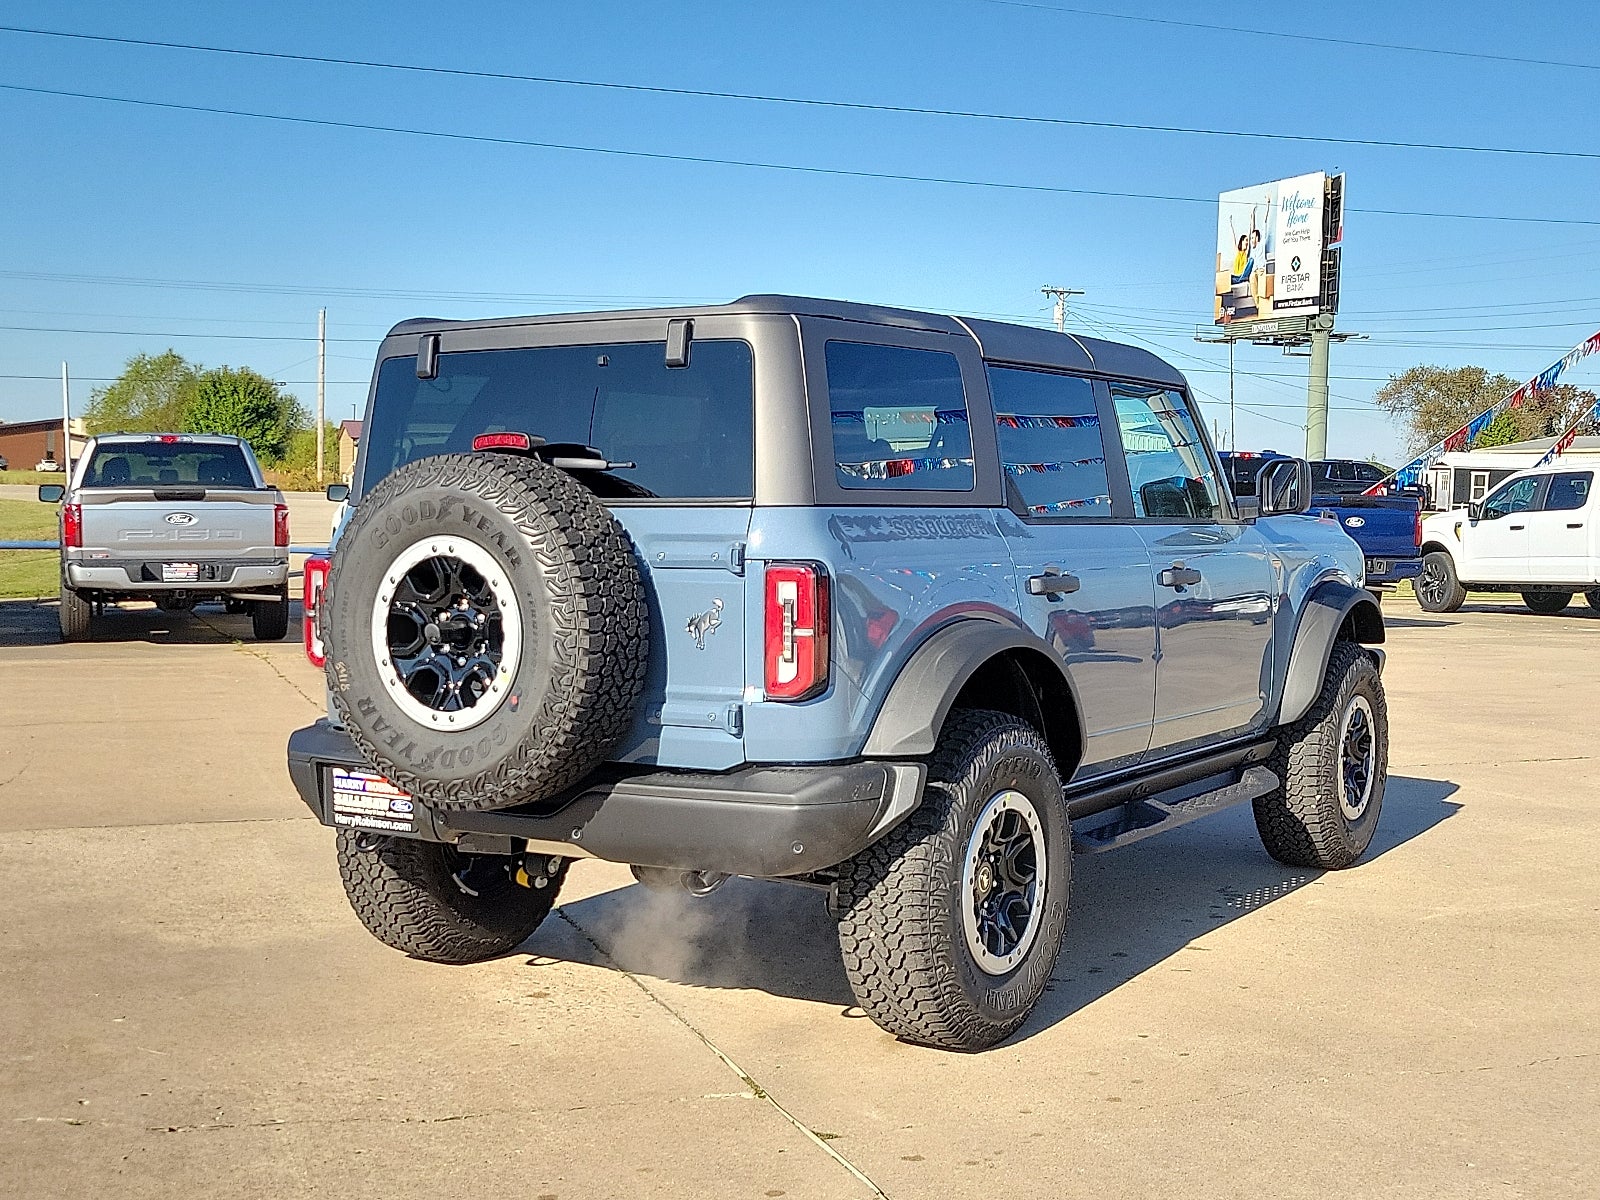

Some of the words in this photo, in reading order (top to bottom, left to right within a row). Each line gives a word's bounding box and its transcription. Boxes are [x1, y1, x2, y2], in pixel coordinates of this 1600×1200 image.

[1281, 190, 1316, 214] Welcome
[1286, 211, 1309, 228] Home
[1281, 272, 1310, 284] FIRSTAR
[118, 529, 243, 541] F-150
[890, 517, 991, 538] SASQUATCH
[334, 813, 412, 831] HarryRobinson.com
